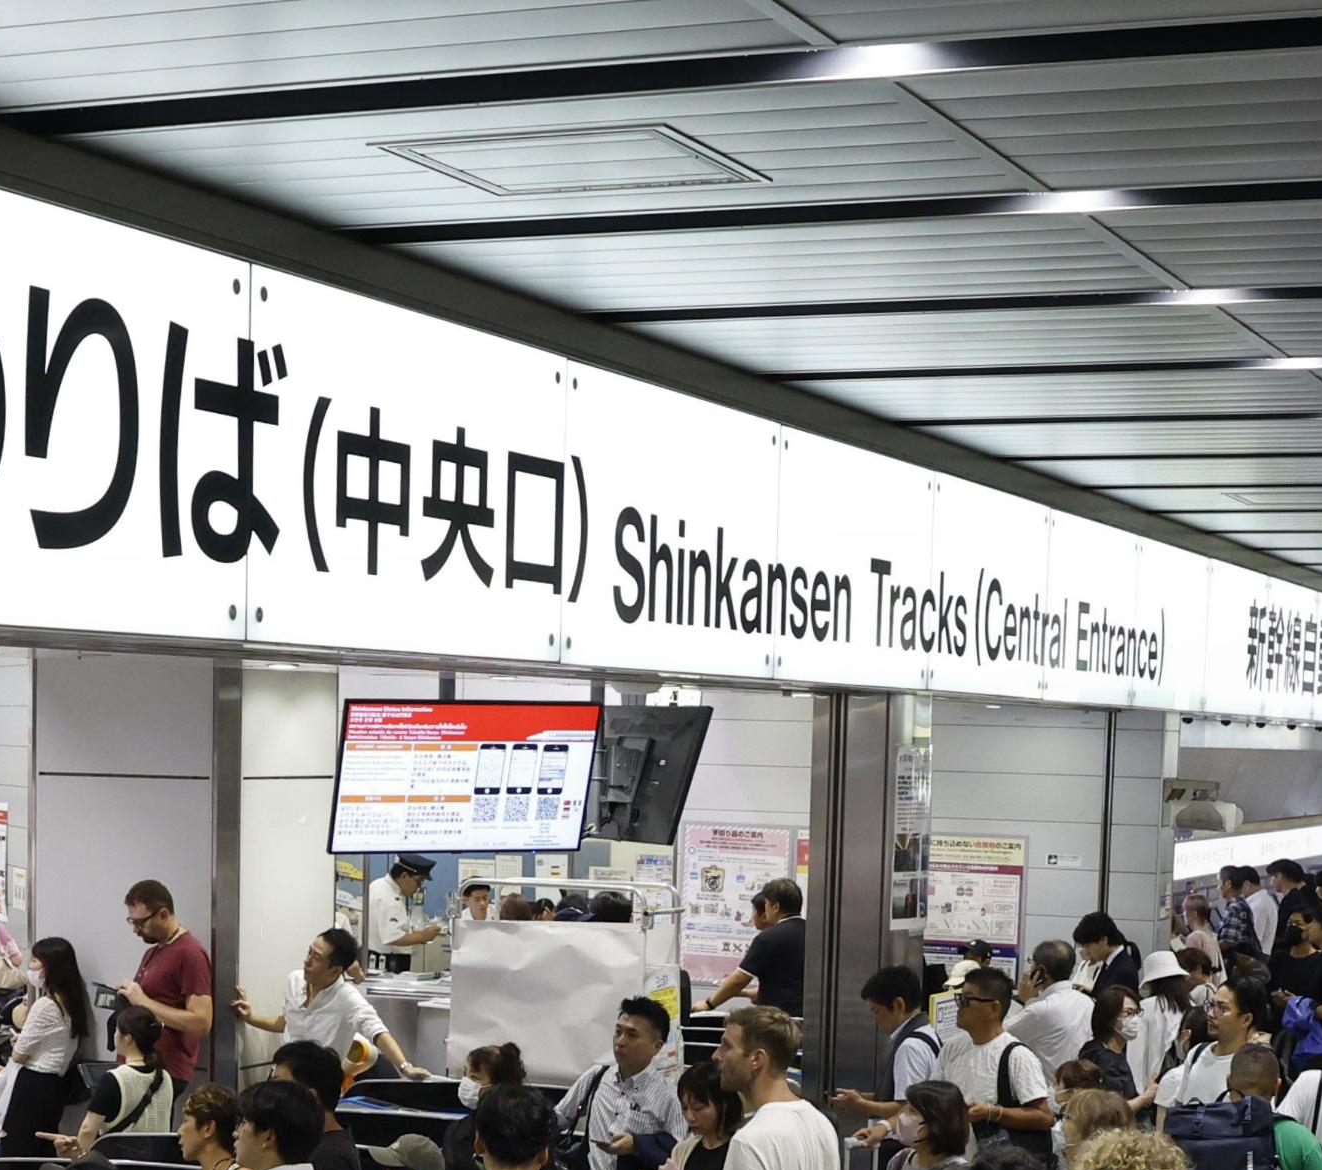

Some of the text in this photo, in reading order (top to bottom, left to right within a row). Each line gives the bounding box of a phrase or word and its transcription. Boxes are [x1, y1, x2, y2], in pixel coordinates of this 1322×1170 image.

[613, 506, 852, 643] Shinkansen
[870, 557, 968, 657] Tracks
[975, 568, 1070, 670] (Central
[1077, 600, 1167, 684] Entrance)
